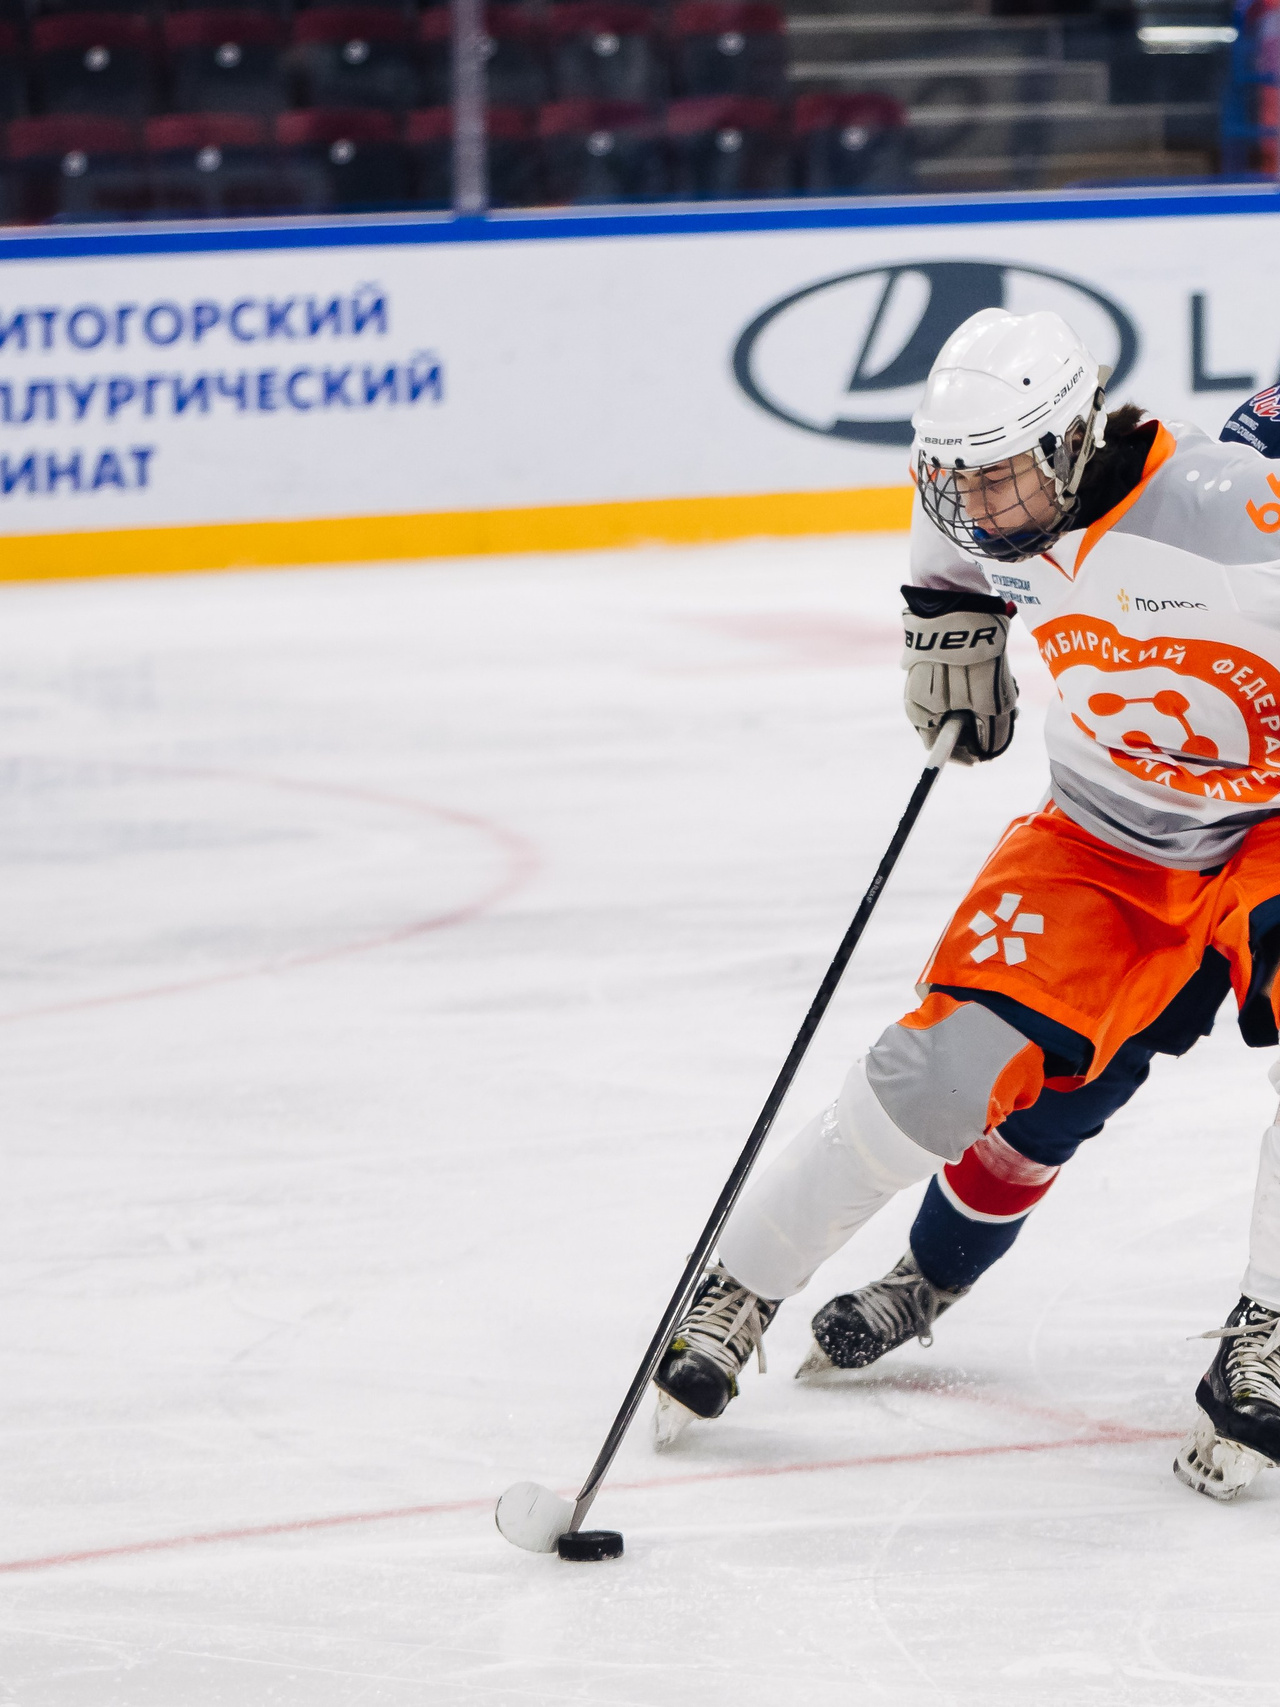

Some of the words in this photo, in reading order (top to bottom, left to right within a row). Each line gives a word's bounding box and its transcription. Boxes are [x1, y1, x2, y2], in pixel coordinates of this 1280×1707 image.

[0, 283, 389, 352] ИТОГОРСКИЙ
[924, 436, 963, 446] BAUER
[1236, 425, 1268, 452] COMPANY
[0, 448, 153, 494] ИНАТ
[1135, 597, 1210, 613] ПОЛЮС
[904, 626, 998, 651] AUER
